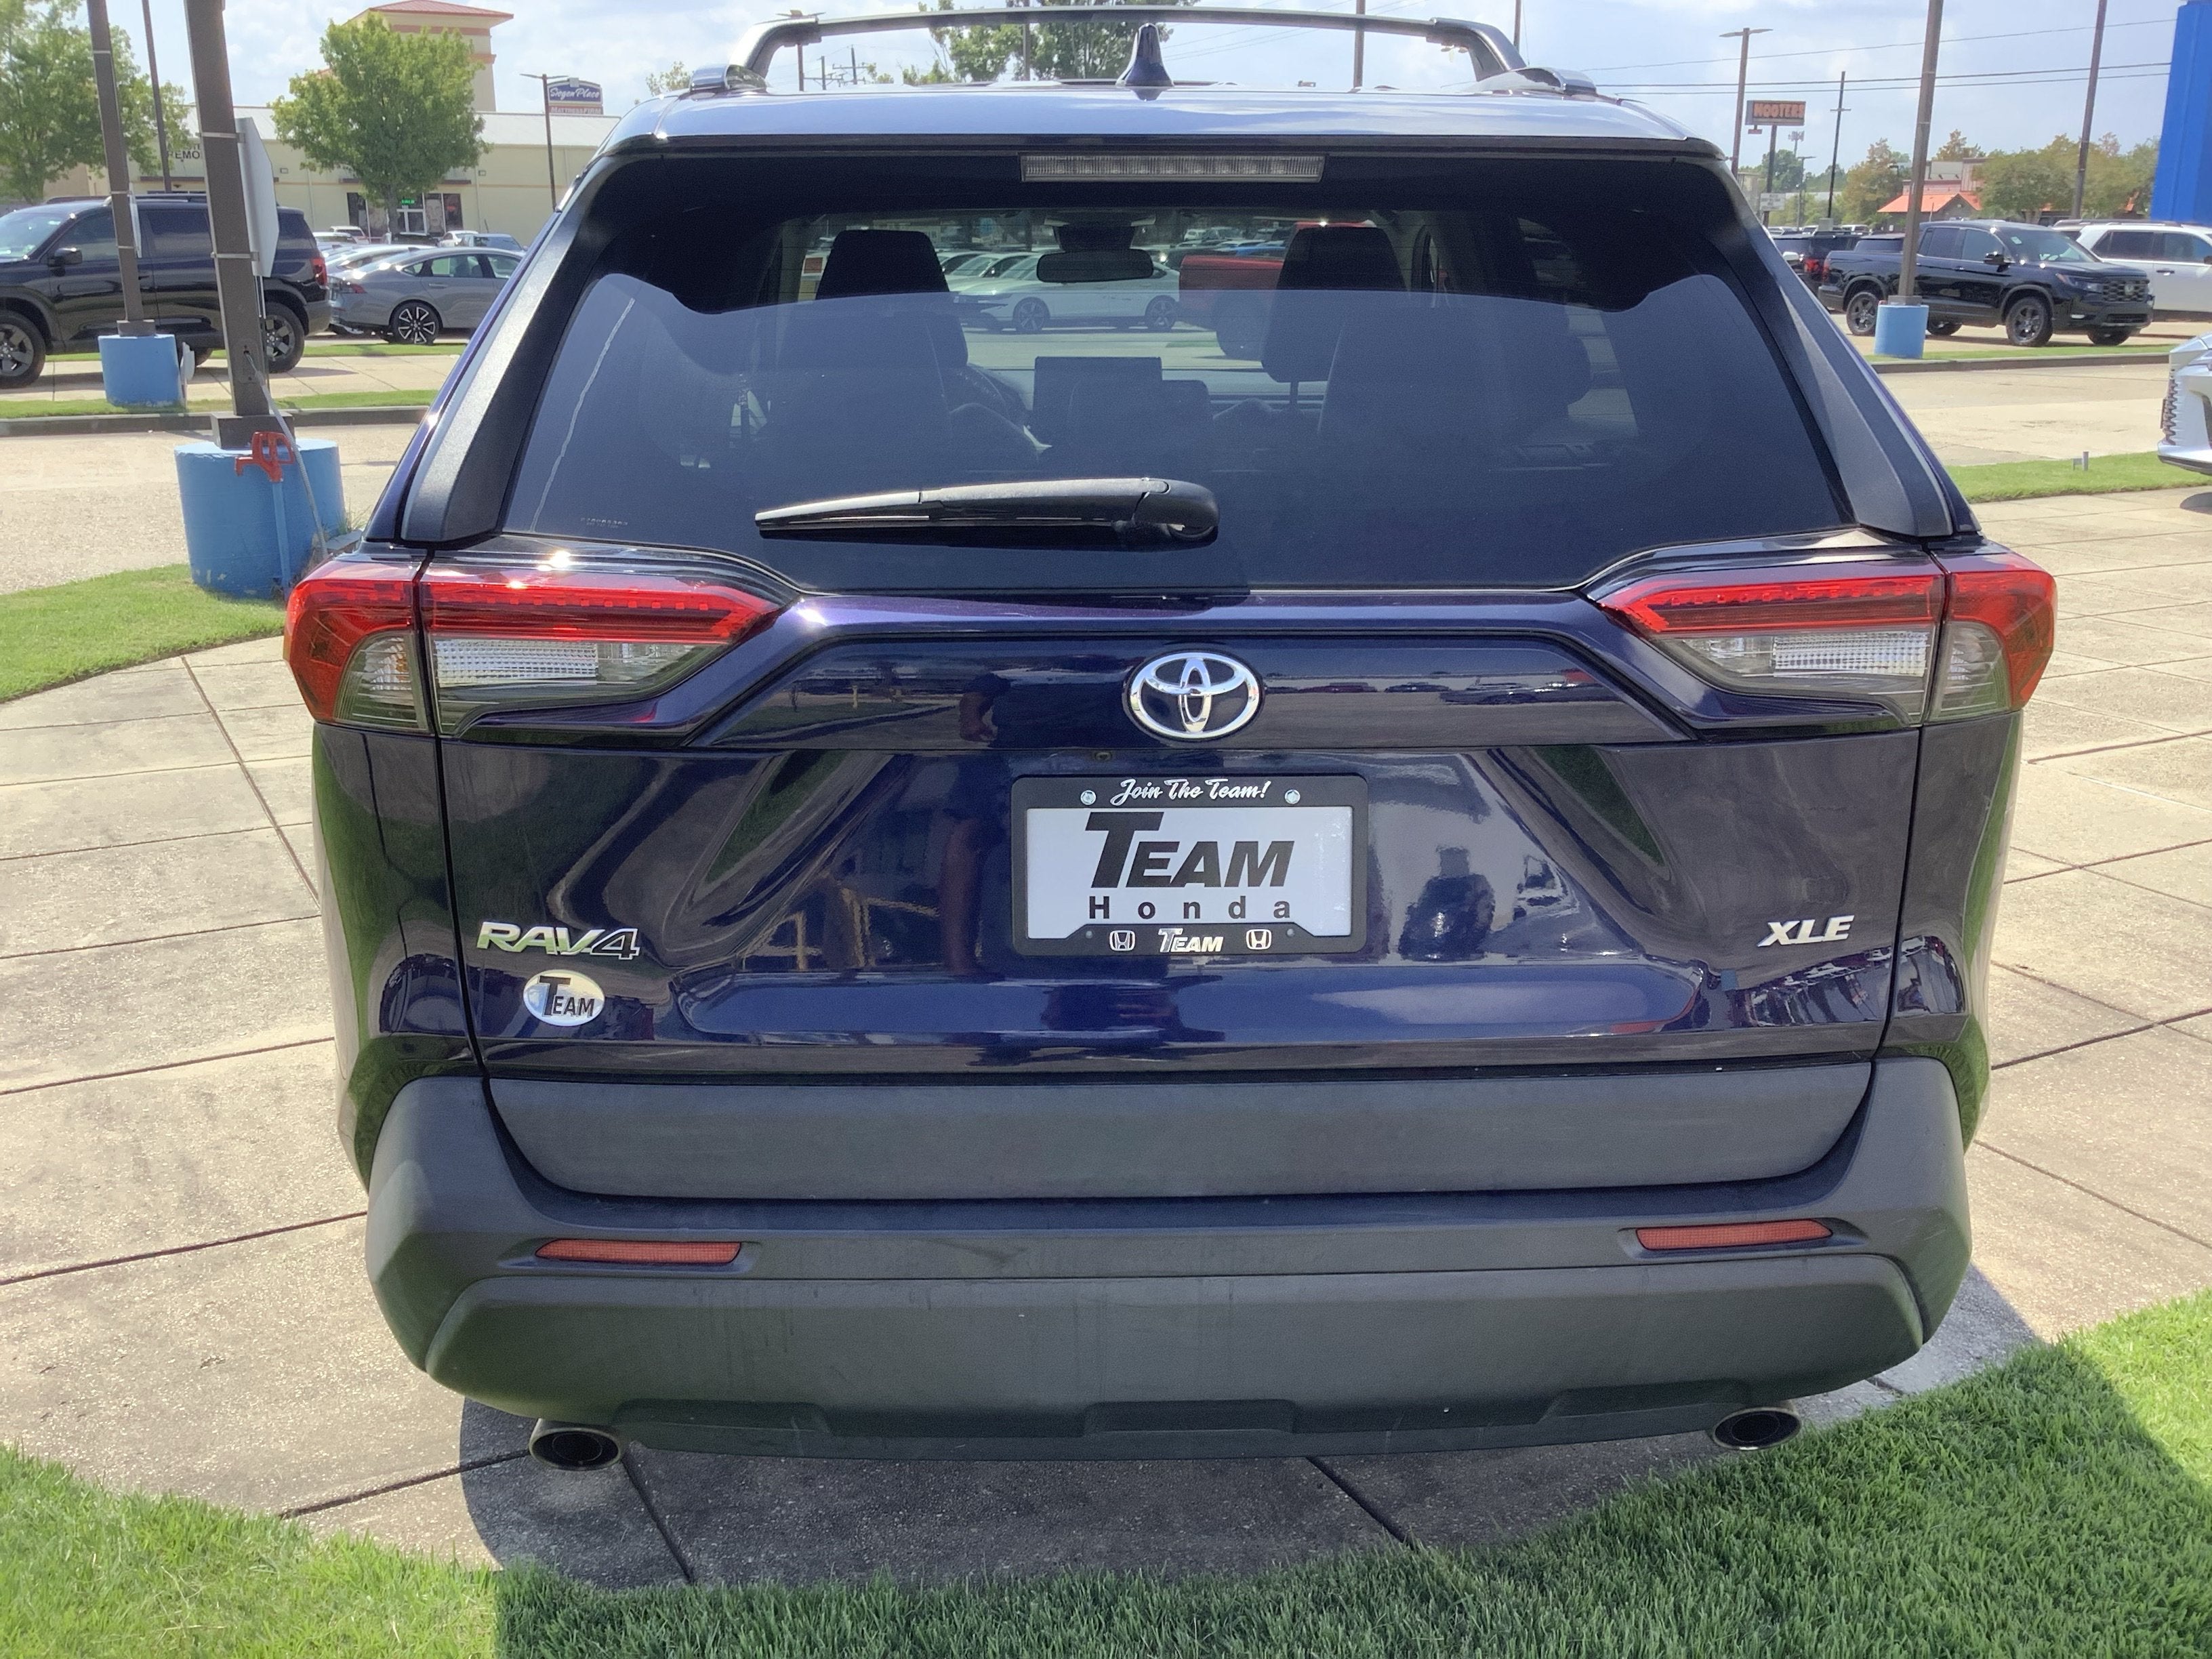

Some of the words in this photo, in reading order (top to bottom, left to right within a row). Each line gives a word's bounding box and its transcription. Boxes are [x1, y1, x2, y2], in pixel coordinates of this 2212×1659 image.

[575, 87, 600, 98] Place
[1754, 102, 1805, 118] HOOTERS
[1109, 778, 1163, 806] Join
[1163, 779, 1202, 800] The
[1206, 779, 1272, 800] Team!
[1084, 811, 1295, 888] TEAM
[1088, 895, 1291, 920] Honda
[476, 921, 640, 960] RAV4
[1158, 928, 1224, 953] TEAM
[1757, 915, 1855, 947] XLE
[539, 975, 595, 1017] TEAM
